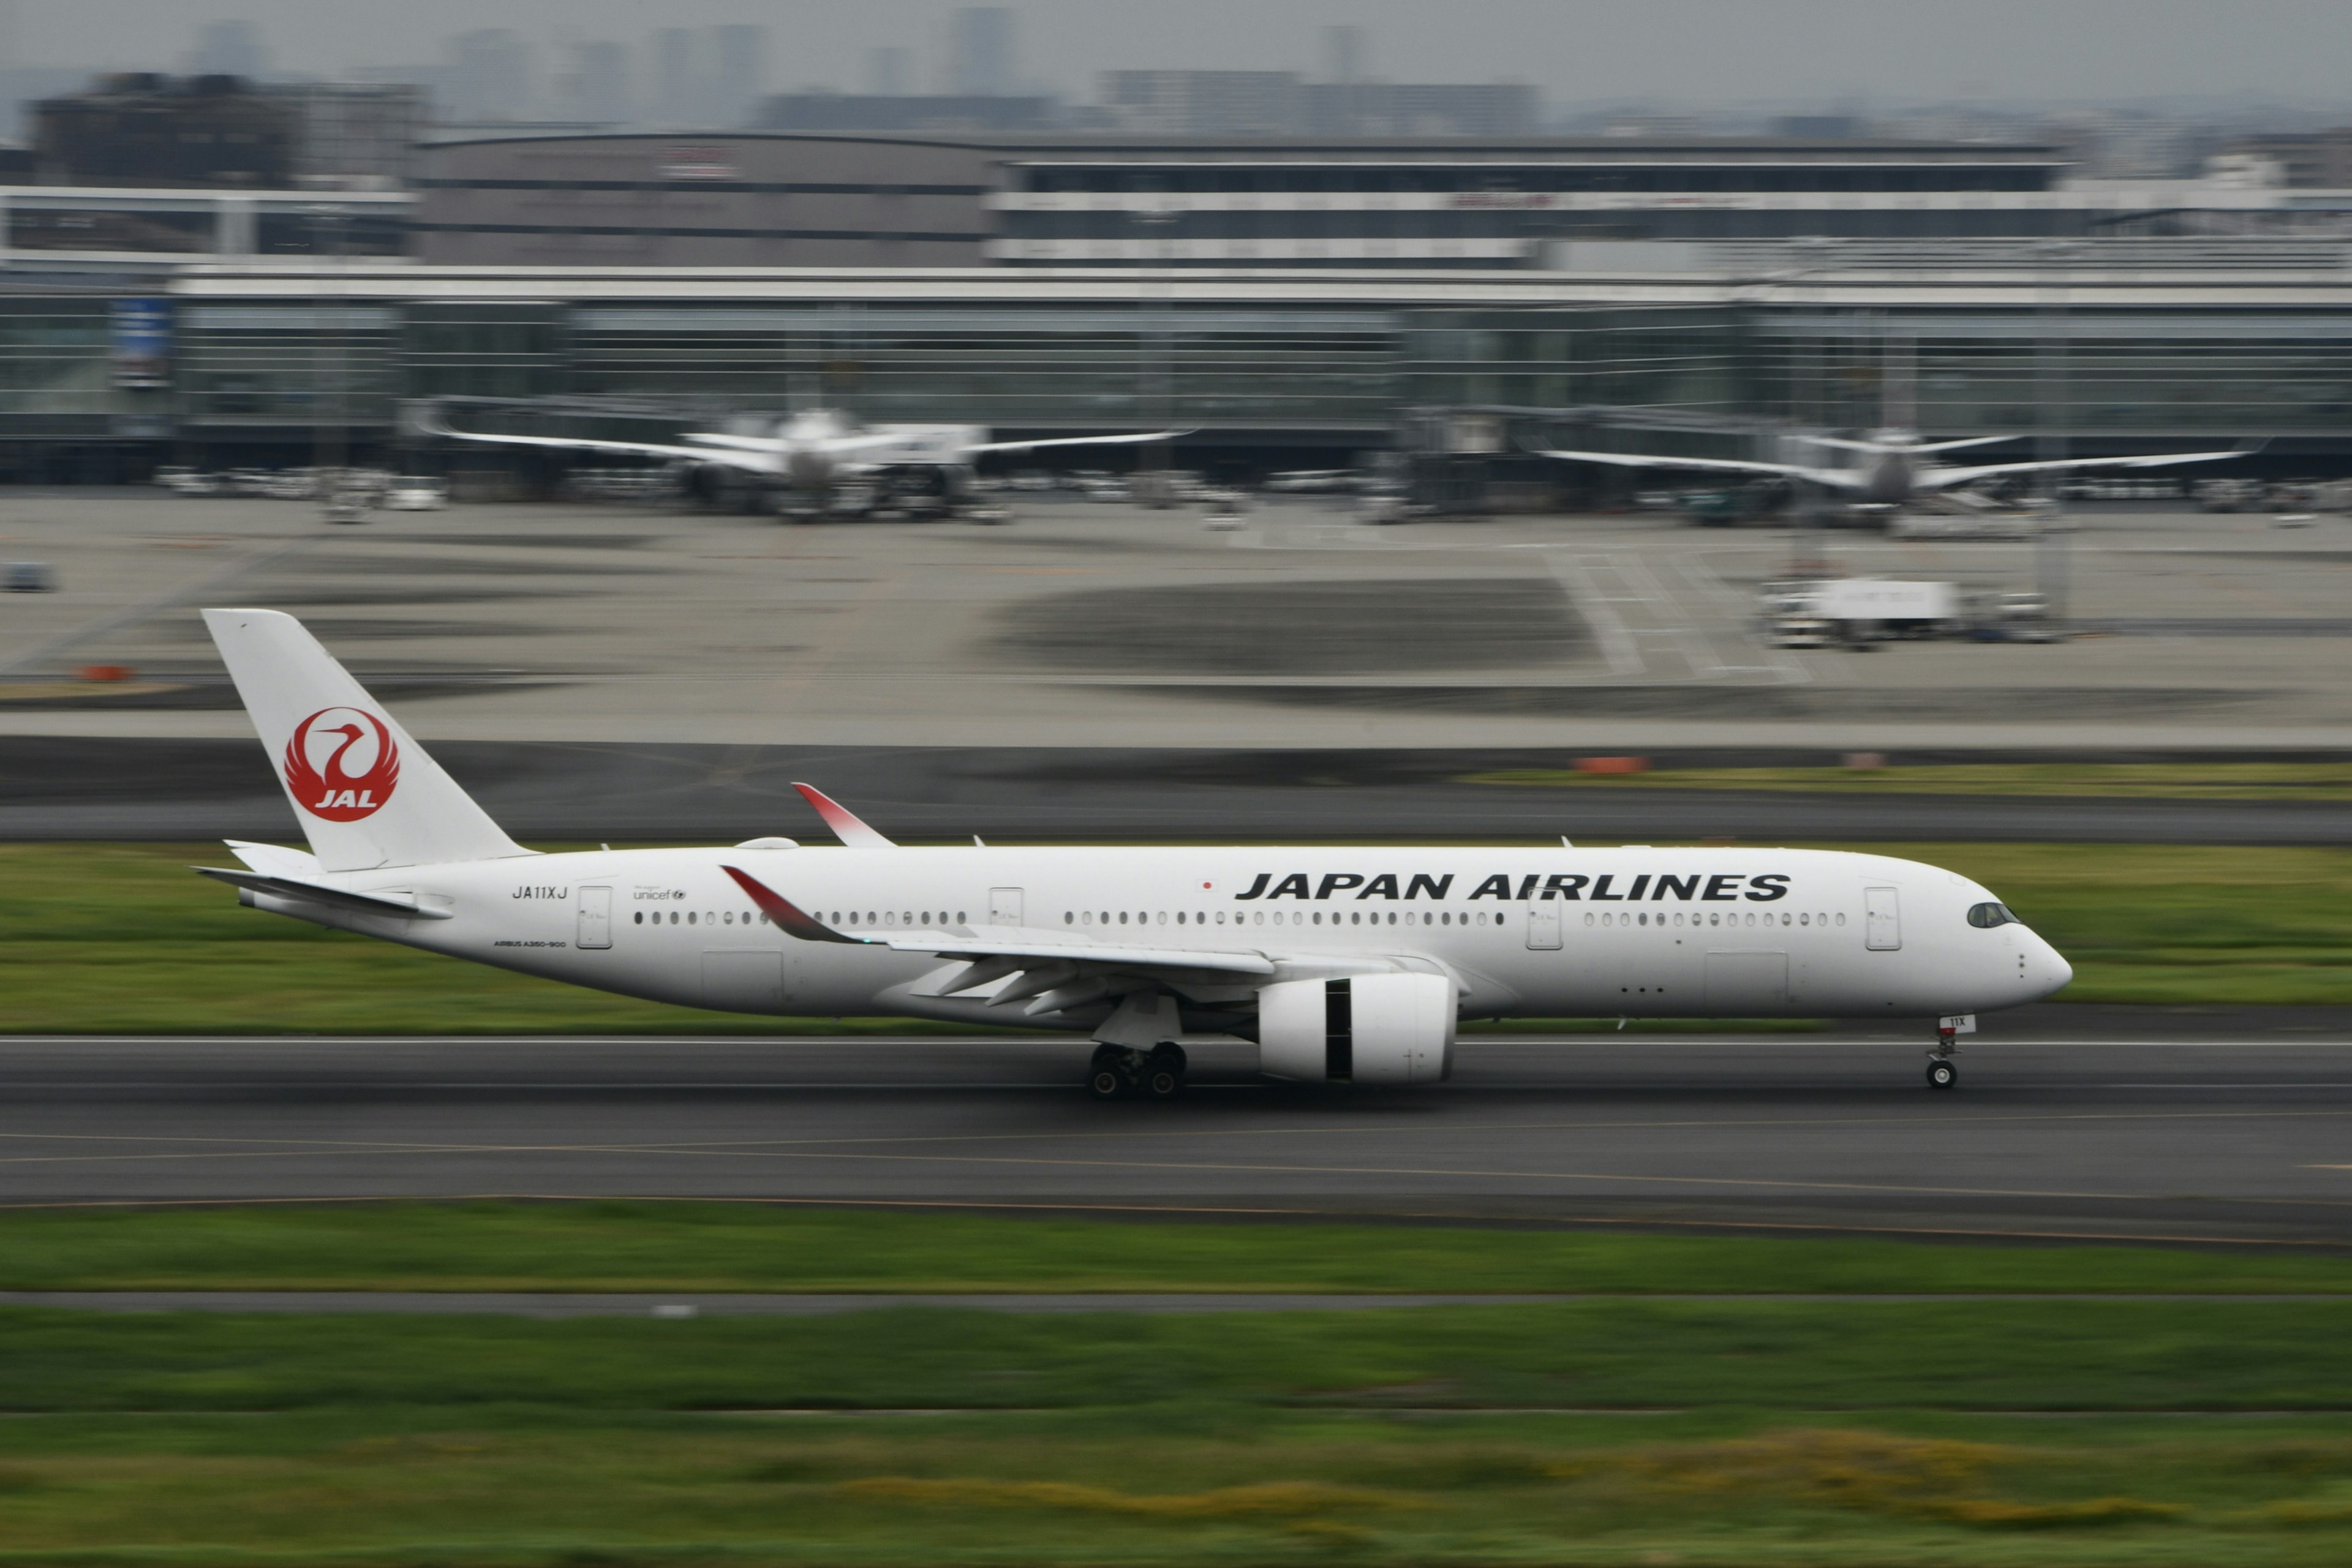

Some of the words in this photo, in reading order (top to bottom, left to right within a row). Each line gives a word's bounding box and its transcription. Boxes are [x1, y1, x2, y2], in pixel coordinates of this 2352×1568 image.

[314, 790, 377, 808] JAL
[512, 886, 567, 899] JA11XJ
[1234, 873, 1455, 900] JAPAN
[1468, 874, 1791, 901] AIRLINES
[633, 889, 671, 900] unicef
[1950, 1017, 1966, 1027] 11X
